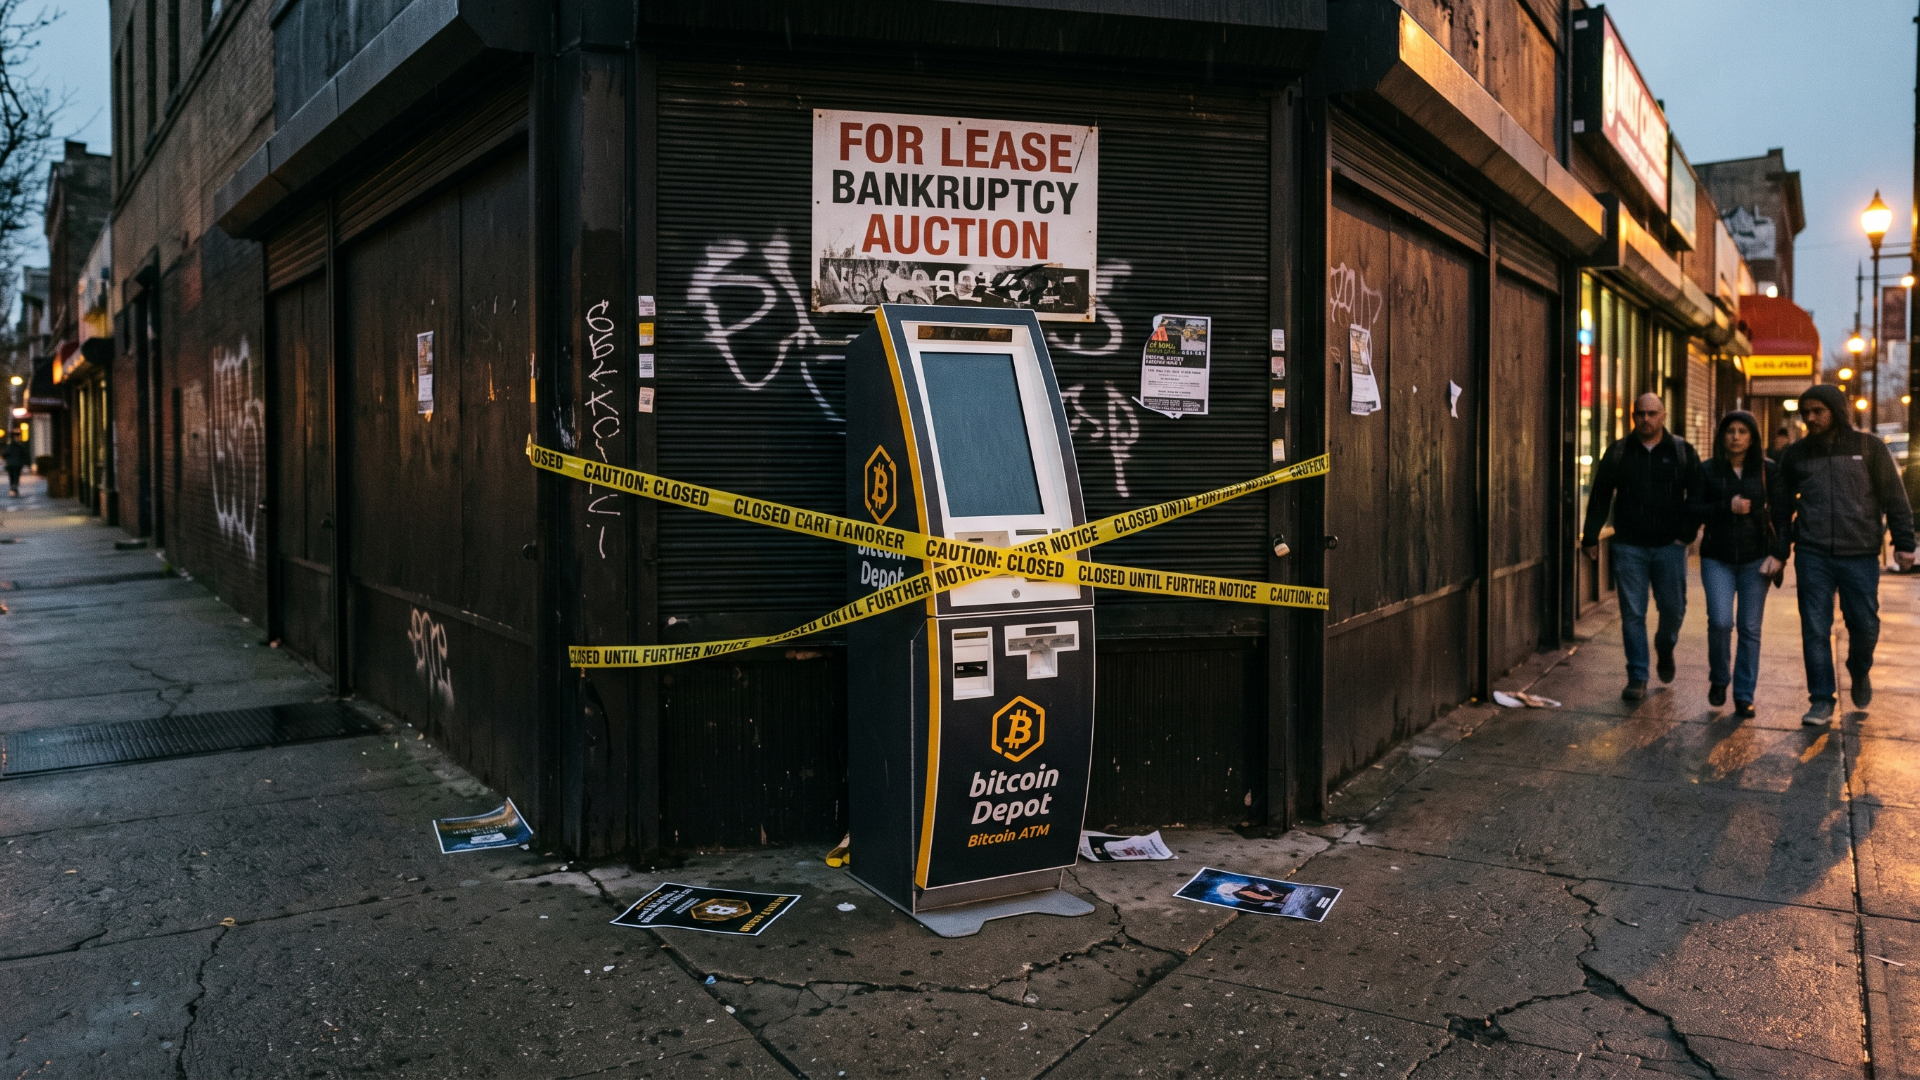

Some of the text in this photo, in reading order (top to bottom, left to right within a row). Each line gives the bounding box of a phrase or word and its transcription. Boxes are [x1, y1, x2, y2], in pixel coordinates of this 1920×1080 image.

[840, 122, 1073, 173] FOR LEASE
[832, 170, 1079, 215] BANKRUPTCY
[861, 213, 1049, 260] AUCTION
[583, 463, 649, 492] CAUTION:
[653, 480, 710, 507] CLOSED
[733, 498, 791, 525] CLOSED
[926, 539, 1002, 569] CAUTION:
[1006, 553, 1065, 578] CLOSED
[1078, 565, 1125, 586] CLOSED
[1129, 571, 1162, 590] UNTIL
[1166, 575, 1216, 596] FURTHER
[1219, 581, 1257, 600] NOTICE
[1270, 587, 1314, 605] CAUTION:
[570, 650, 600, 664] CLOSED
[604, 650, 639, 664] UNTIL
[642, 646, 701, 663] FURTHER
[703, 640, 752, 656] NOTICE
[865, 575, 933, 613] FURTHER
[1050, 525, 1099, 554] NOTICE
[1113, 507, 1158, 534] CLOSED
[1160, 498, 1193, 519] UNTIL
[860, 560, 905, 590] Depot
[969, 763, 1059, 798] bitcoin
[971, 793, 1053, 825] Depot
[967, 824, 1051, 848] Bitcoin ATM
